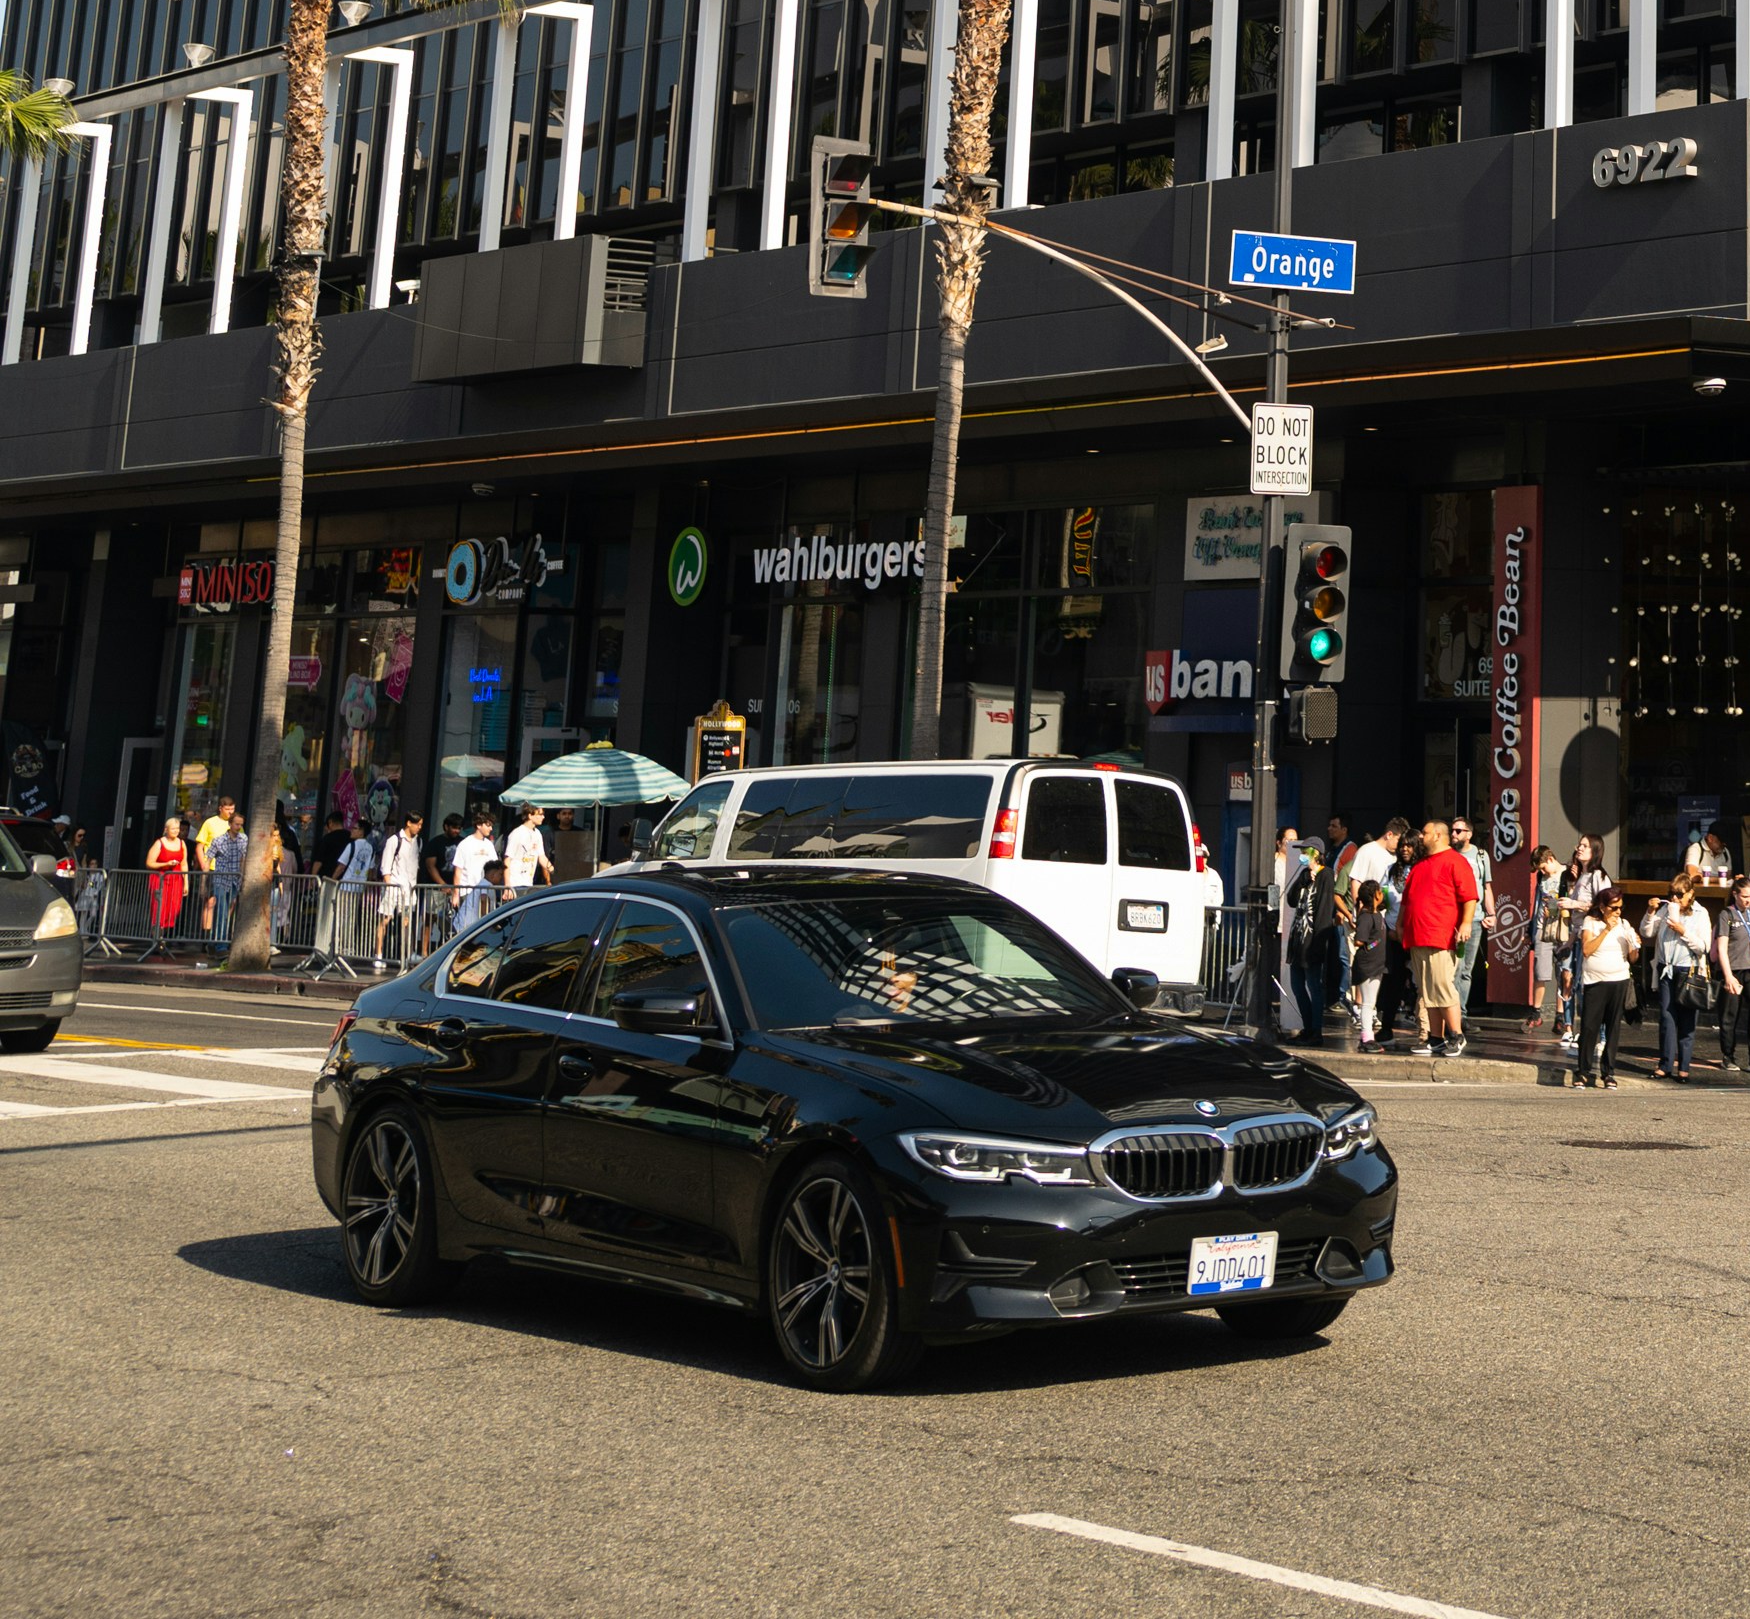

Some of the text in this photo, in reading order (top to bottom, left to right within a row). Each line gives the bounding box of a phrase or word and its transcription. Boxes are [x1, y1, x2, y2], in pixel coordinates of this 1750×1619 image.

[1593, 137, 1698, 188] 6922
[1252, 246, 1335, 286] Orange
[1257, 416, 1308, 437] DO NOT
[1256, 445, 1308, 465] BLOCK
[1255, 470, 1308, 485] INTERSECTION
[754, 535, 926, 590] wahlburgers
[196, 562, 272, 603] MINISO
[1170, 649, 1253, 700] ban
[1453, 680, 1491, 697] SUITE
[1493, 525, 1525, 862] The Coffee Bean
[20, 785, 39, 800] Food
[25, 802, 48, 817] Drink
[1495, 893, 1511, 909] offee
[1208, 1242, 1260, 1255] California
[1197, 1254, 1266, 1283] 9JDD401
